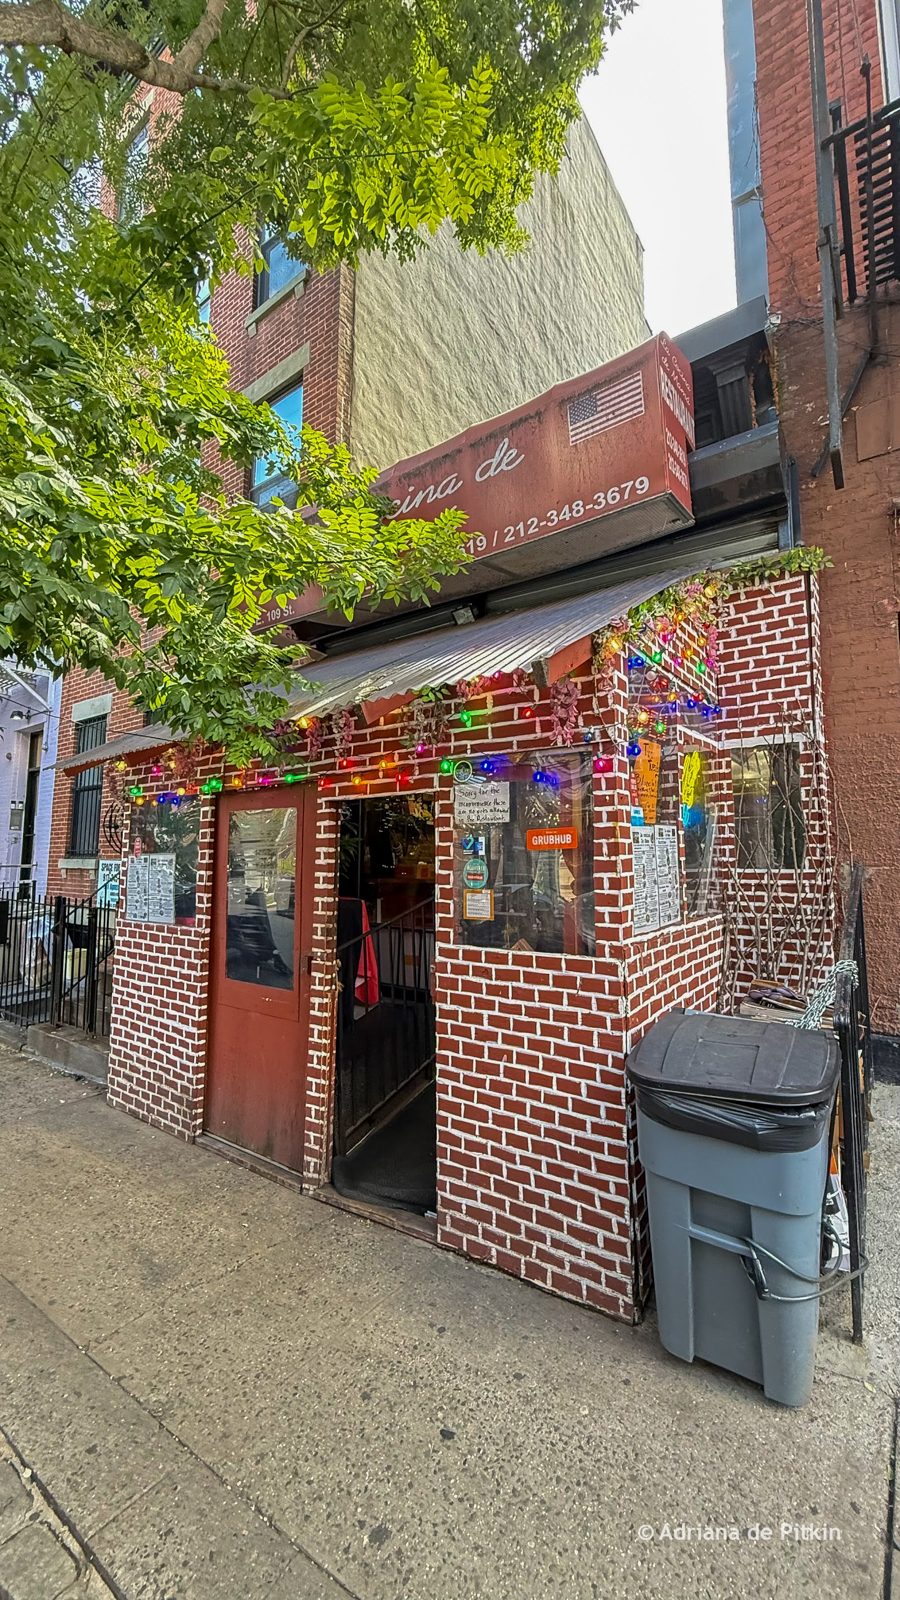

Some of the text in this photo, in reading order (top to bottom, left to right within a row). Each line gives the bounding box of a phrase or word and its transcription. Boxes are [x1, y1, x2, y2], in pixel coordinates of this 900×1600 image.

[386, 438, 524, 519] cina de
[504, 476, 650, 543] 212-348-3679
[266, 608, 281, 621] 109
[532, 834, 572, 845] GRUBHUB
